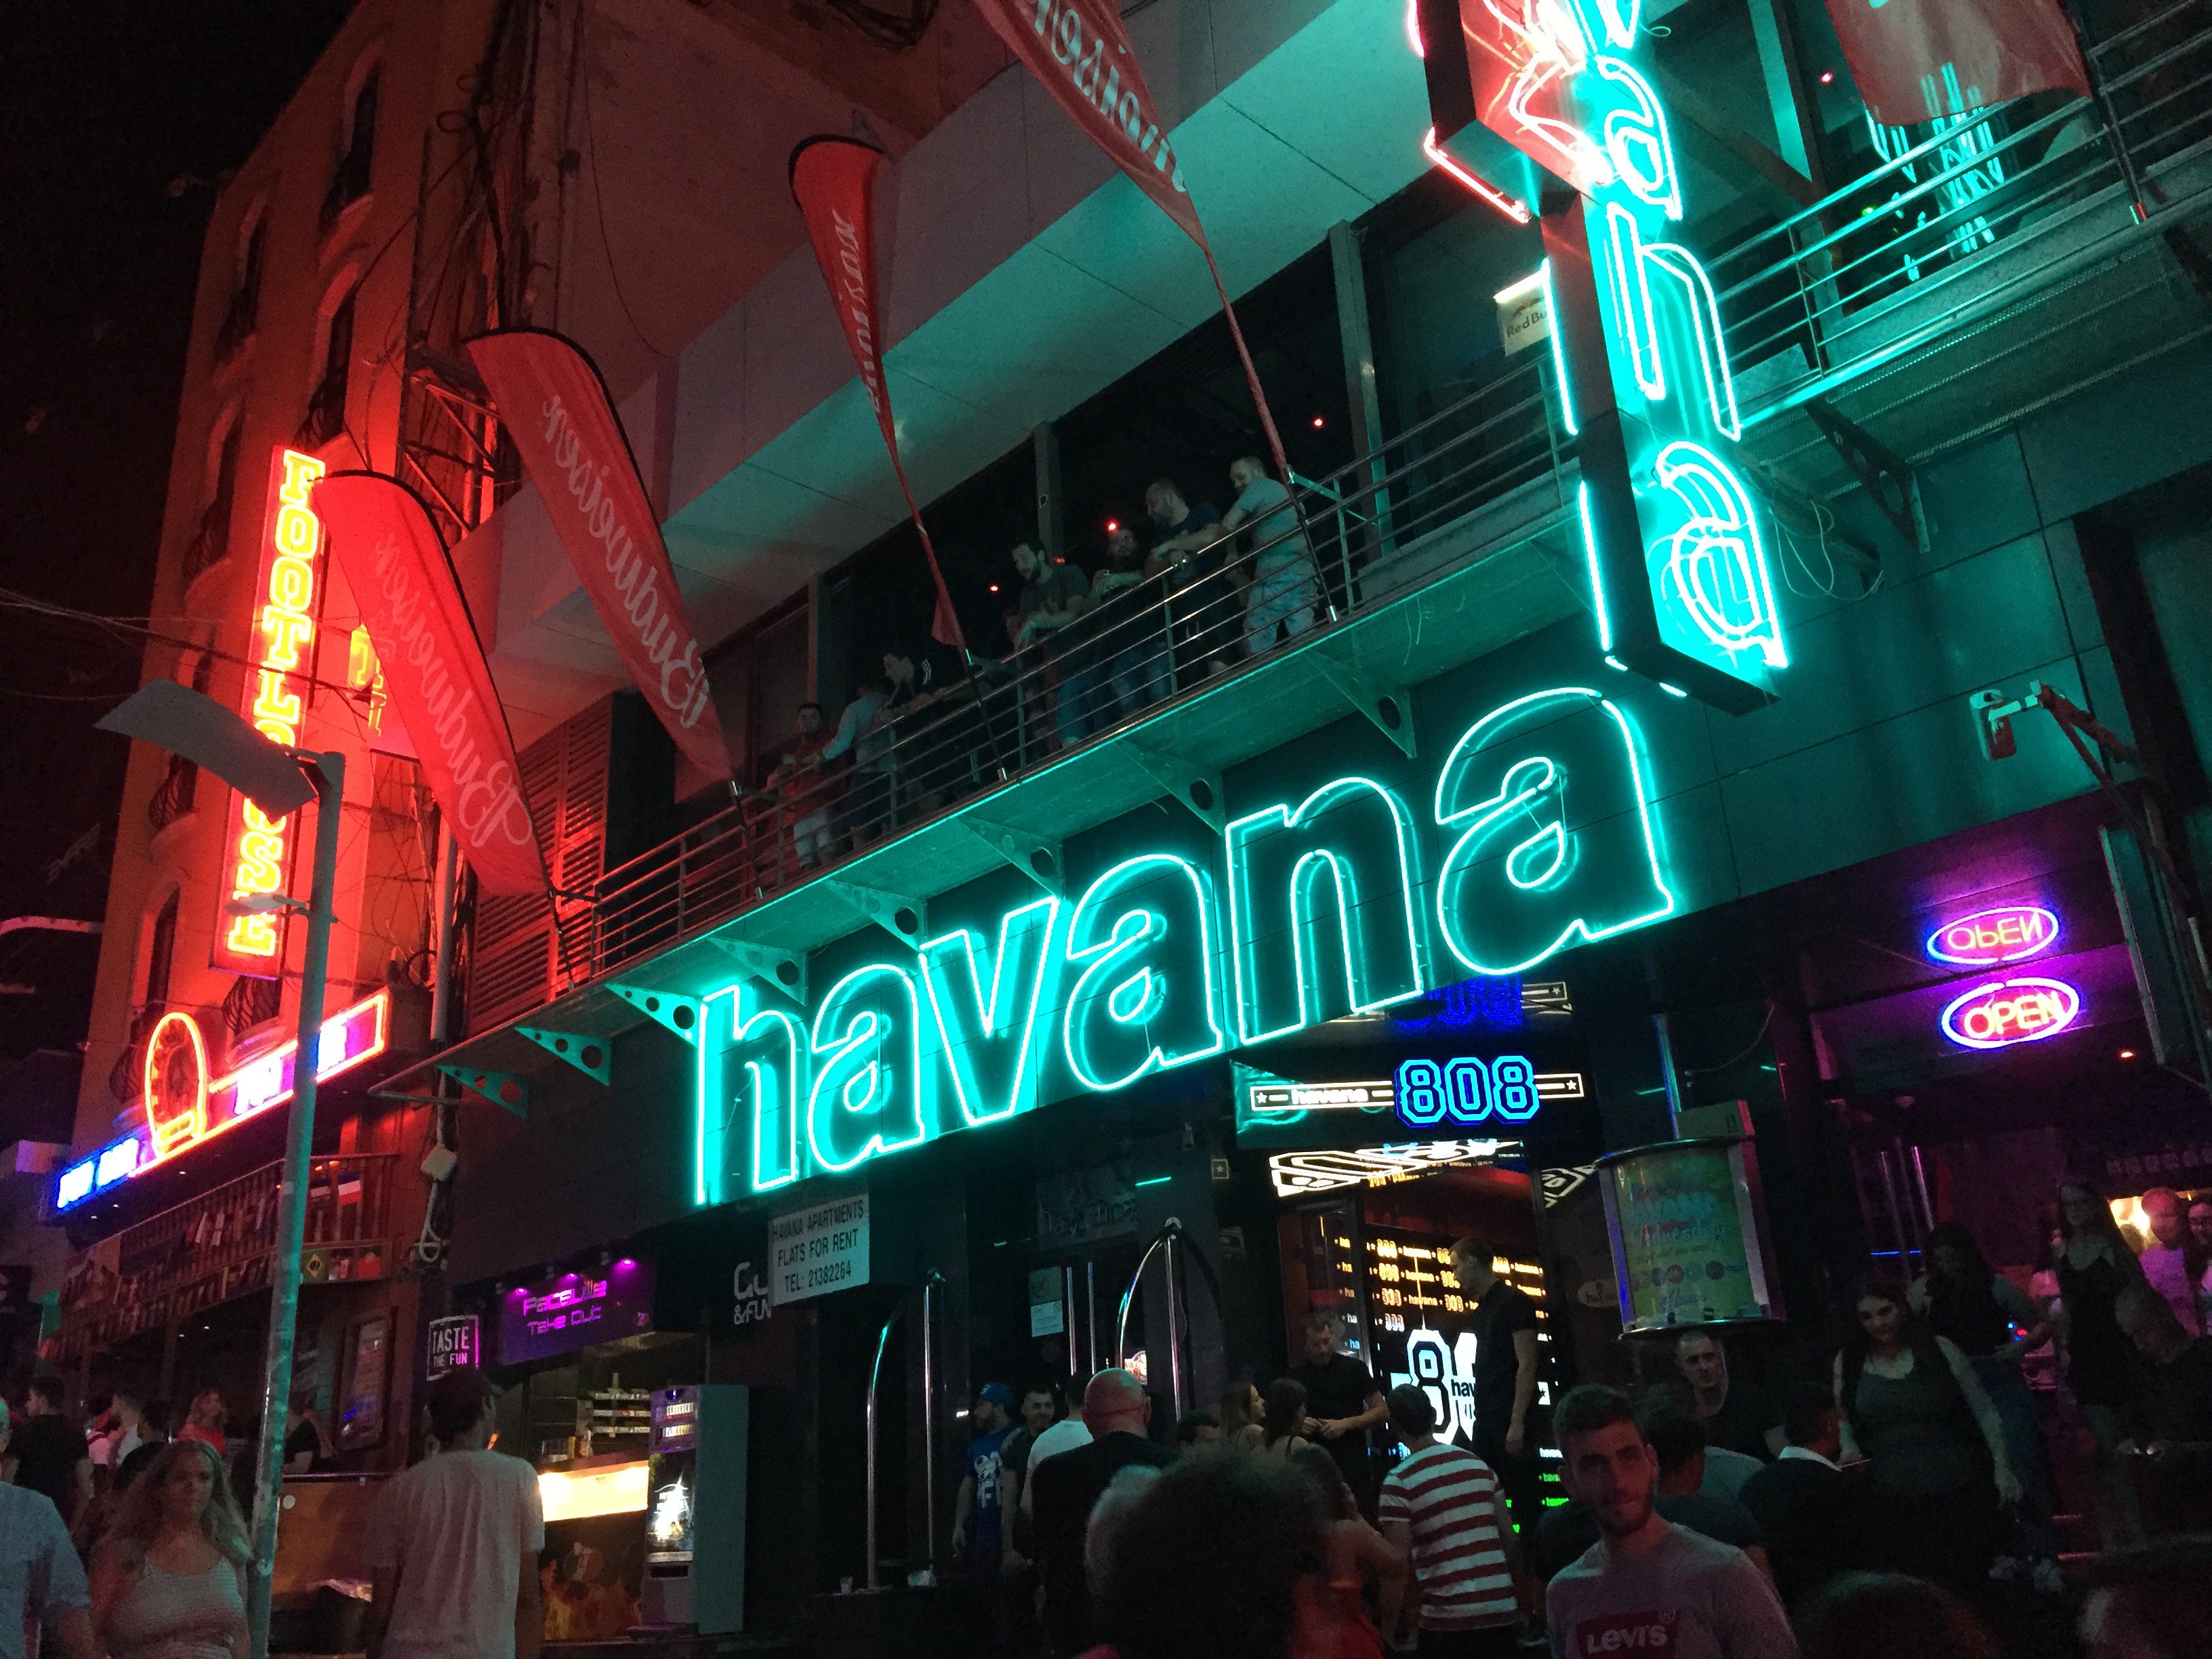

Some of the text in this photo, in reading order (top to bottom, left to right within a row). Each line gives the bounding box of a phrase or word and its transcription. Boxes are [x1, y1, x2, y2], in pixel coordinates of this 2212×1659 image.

[1506, 316, 1530, 338] Red
[693, 684, 1677, 1206] havana
[1964, 990, 2066, 1040] OPEN
[1292, 1054, 1541, 1128] havana 808
[806, 1199, 864, 1233] APARTMENTS
[777, 1228, 859, 1268] FLATS FOR RENT
[808, 1259, 852, 1288] 21382264
[432, 1326, 470, 1354] TASTE
[449, 1352, 468, 1366] FUN
